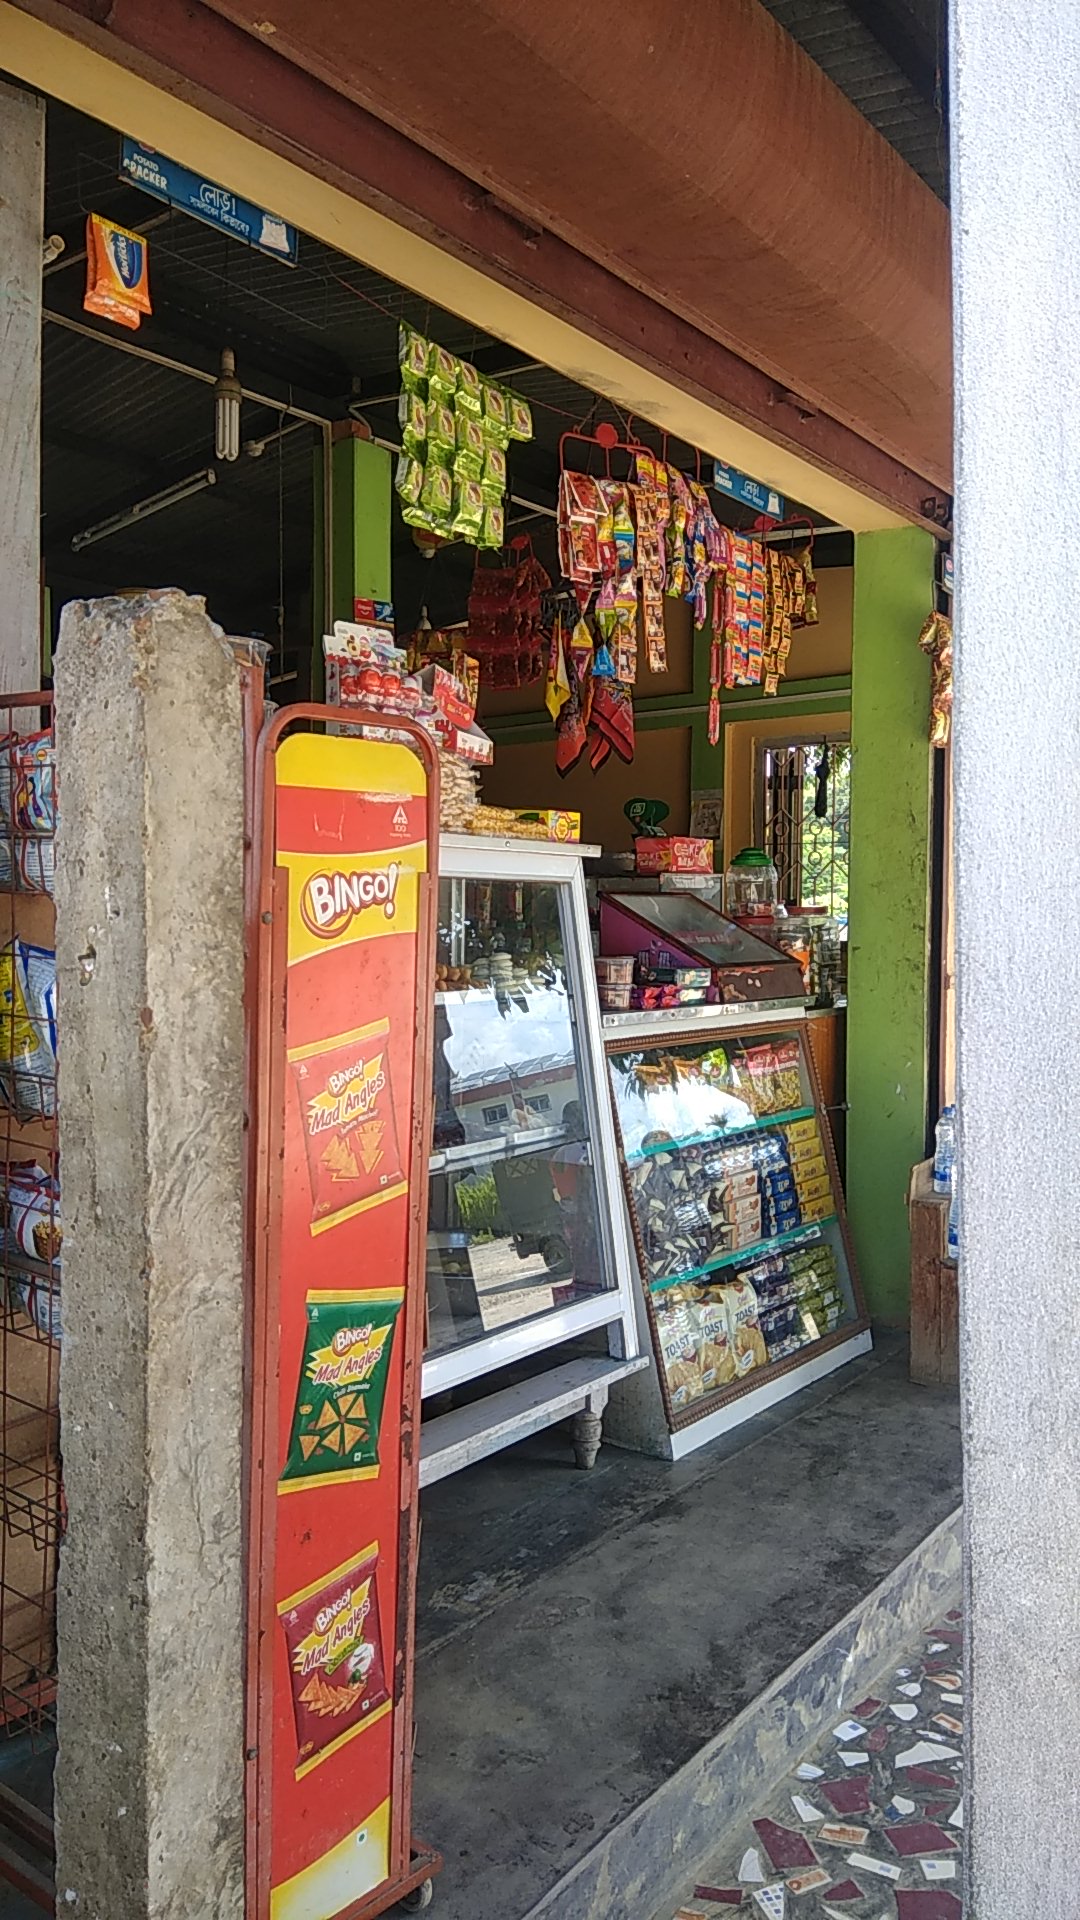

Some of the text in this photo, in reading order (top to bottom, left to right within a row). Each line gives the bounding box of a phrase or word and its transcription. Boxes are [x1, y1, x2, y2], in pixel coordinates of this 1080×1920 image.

[122, 157, 168, 190] CRACKER
[133, 153, 159, 172] POTATO
[308, 861, 400, 926] BINGO!
[328, 1058, 365, 1093] BINGO!
[310, 1097, 341, 1135] Mad
[344, 1071, 385, 1114] Angles
[699, 1320, 724, 1339] TOAST
[734, 1304, 755, 1323] TOAST
[335, 1322, 373, 1350] BINGO!
[665, 1334, 690, 1359] TOAST
[313, 1346, 382, 1383] Mad Angles
[315, 1588, 352, 1633] BINGO!
[302, 1634, 331, 1675] Mad
[332, 1598, 371, 1648] Angles
